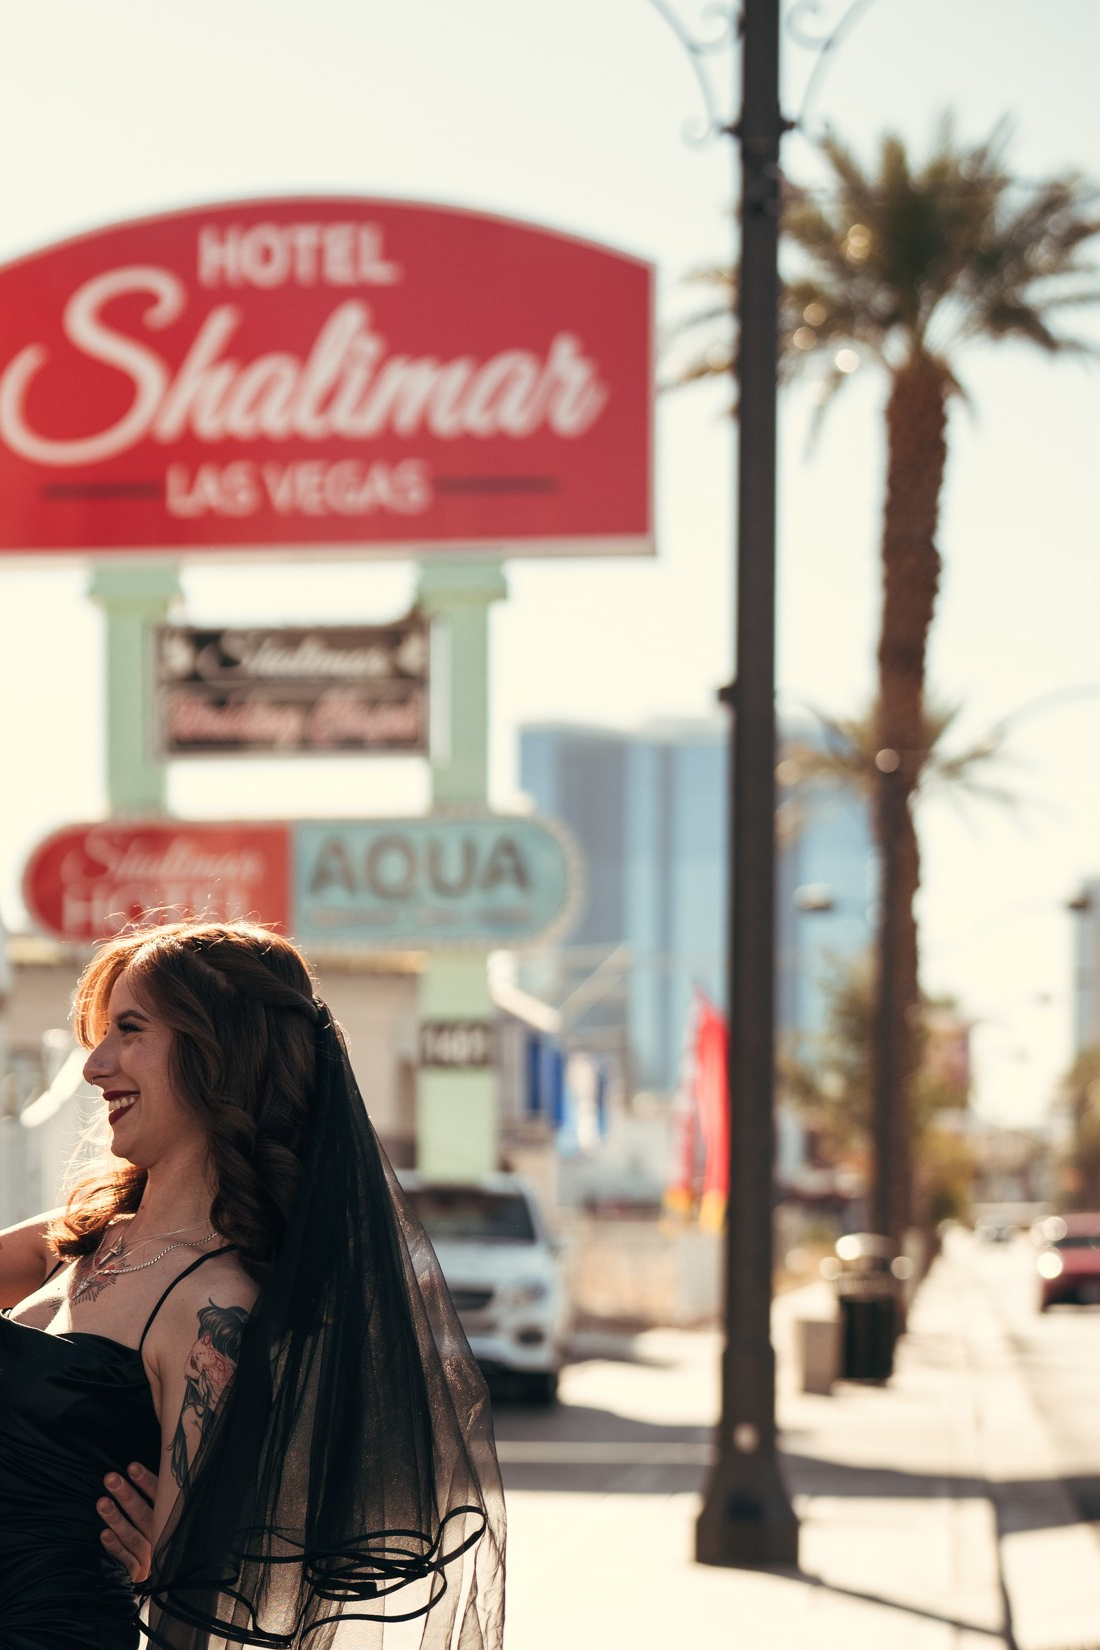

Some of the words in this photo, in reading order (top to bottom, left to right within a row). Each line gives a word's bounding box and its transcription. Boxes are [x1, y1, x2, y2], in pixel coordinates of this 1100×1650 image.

[199, 222, 400, 287] HOTEL
[166, 460, 260, 518] LAS
[263, 457, 434, 517] VEGAS
[60, 824, 265, 886] Shalimar
[309, 834, 532, 901] AQUA
